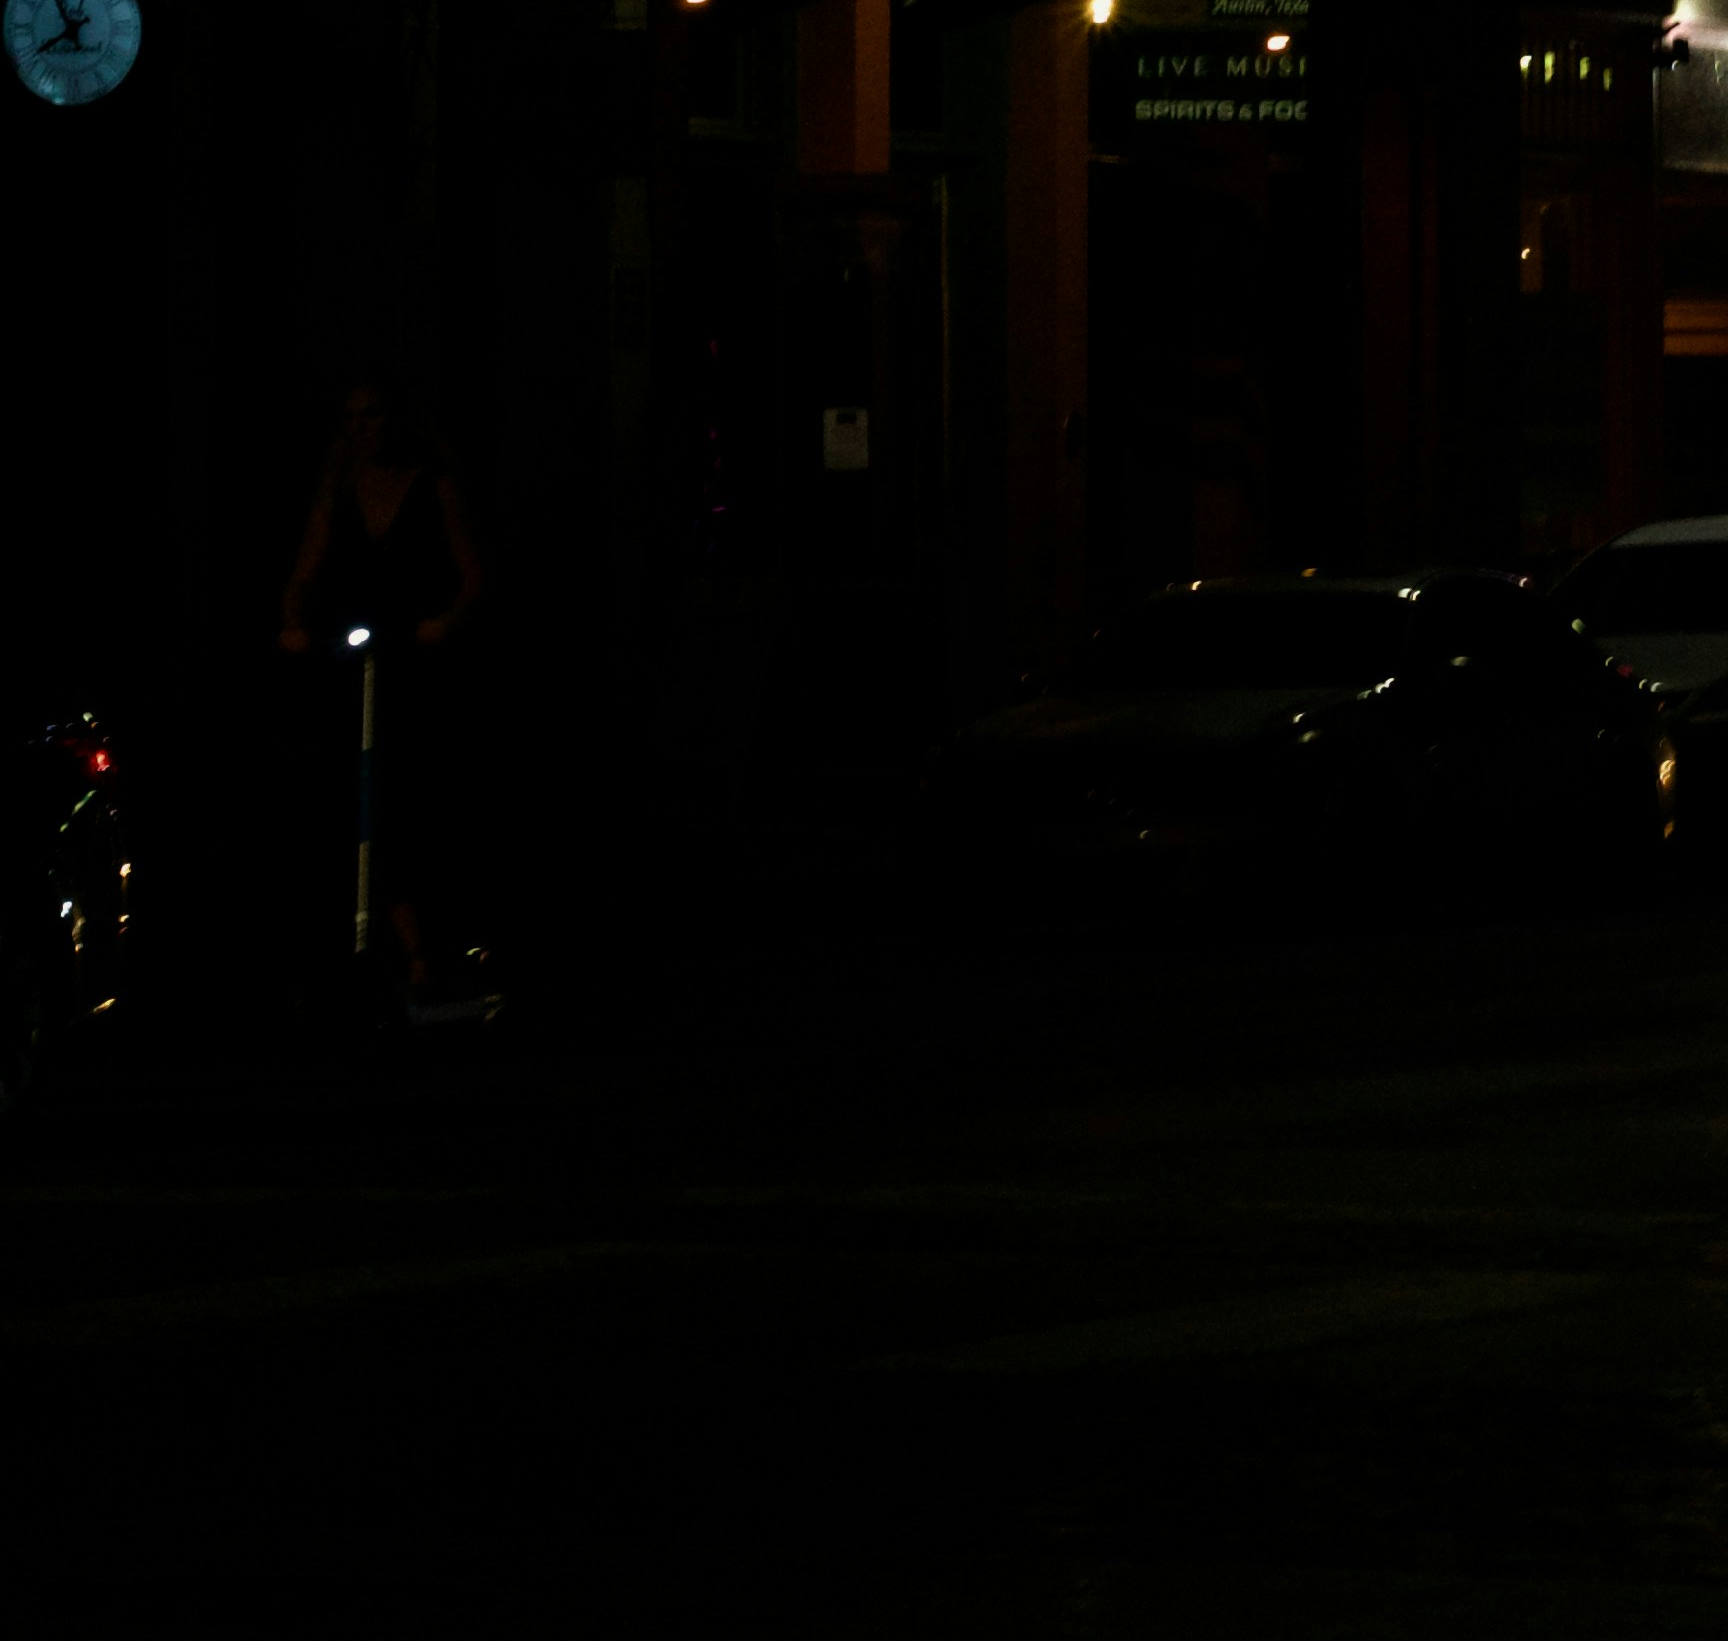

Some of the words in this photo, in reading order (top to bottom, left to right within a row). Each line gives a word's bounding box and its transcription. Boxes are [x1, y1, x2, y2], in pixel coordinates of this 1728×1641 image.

[1136, 54, 1209, 78] LIVE
[1226, 54, 1308, 78] MUSI
[1134, 99, 1235, 122] SPIRITS
